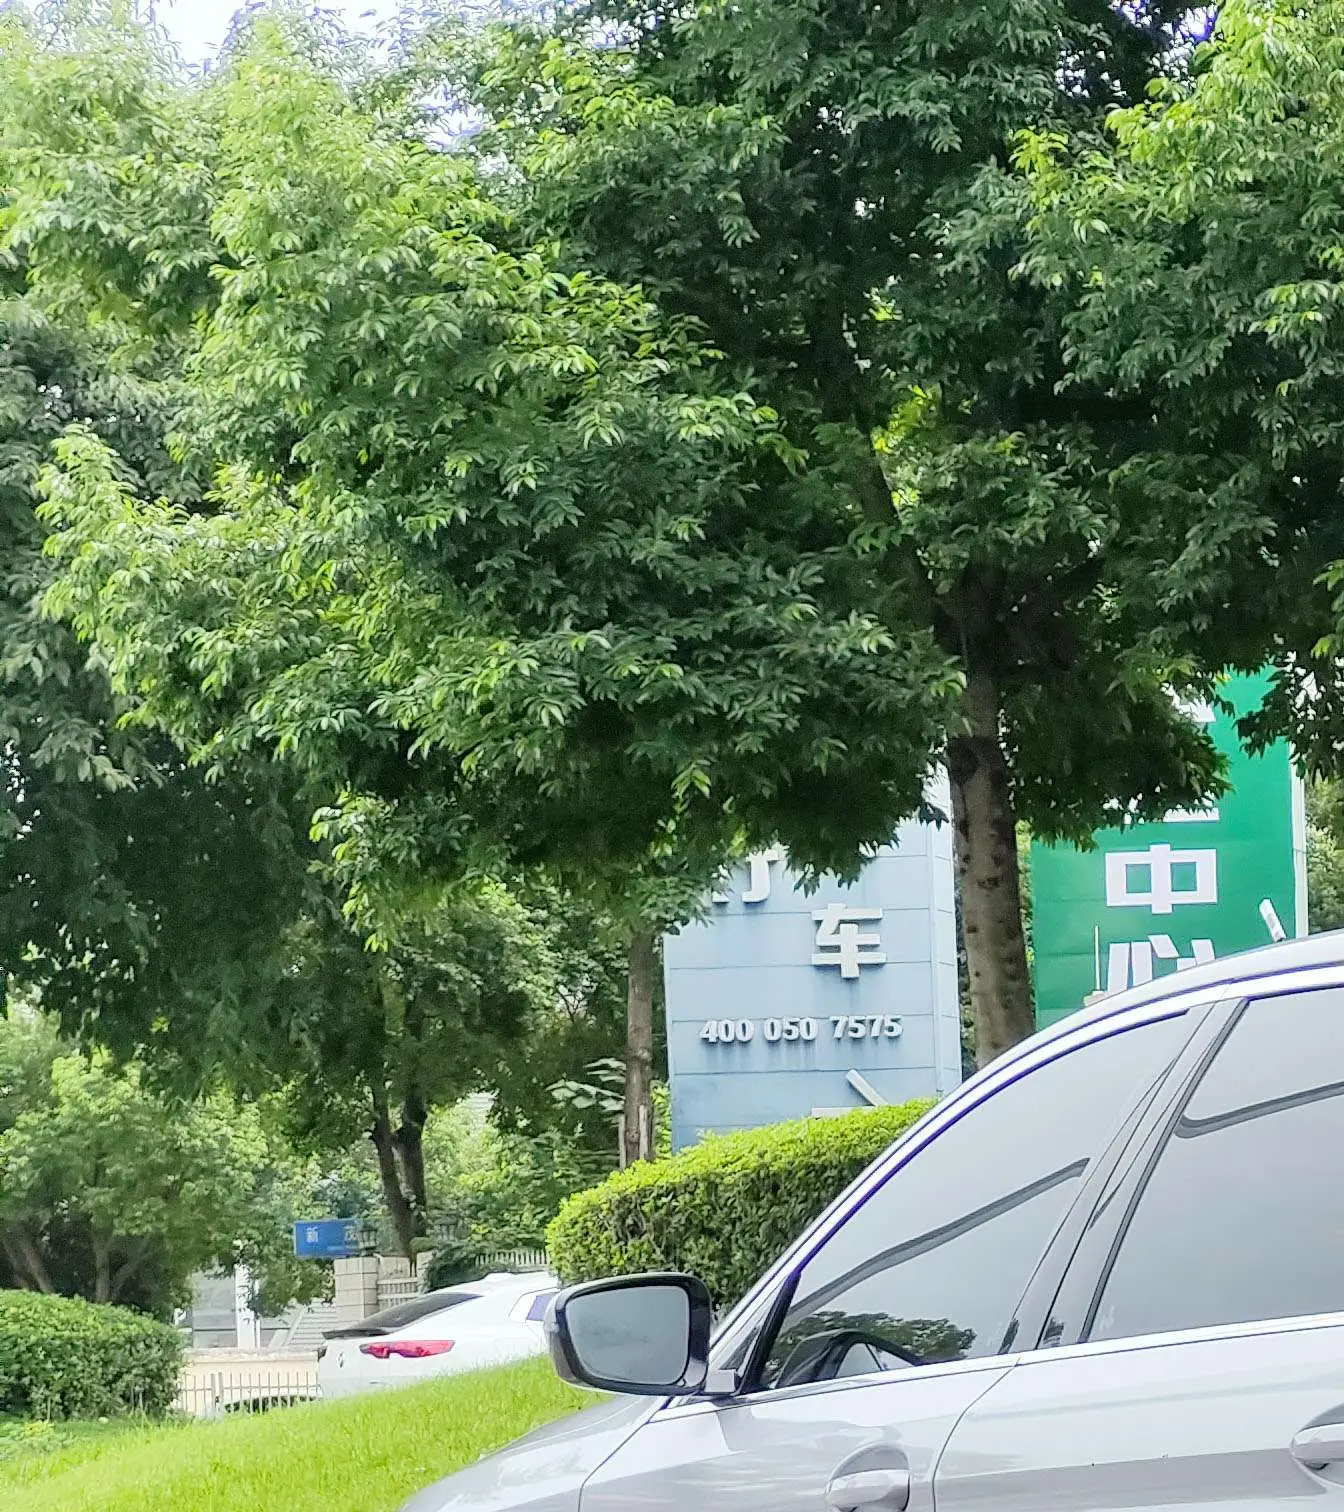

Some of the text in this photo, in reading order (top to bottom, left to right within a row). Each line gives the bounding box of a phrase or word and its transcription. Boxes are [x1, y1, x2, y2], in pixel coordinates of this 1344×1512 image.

[699, 1014, 904, 1044] 400 050 7575
